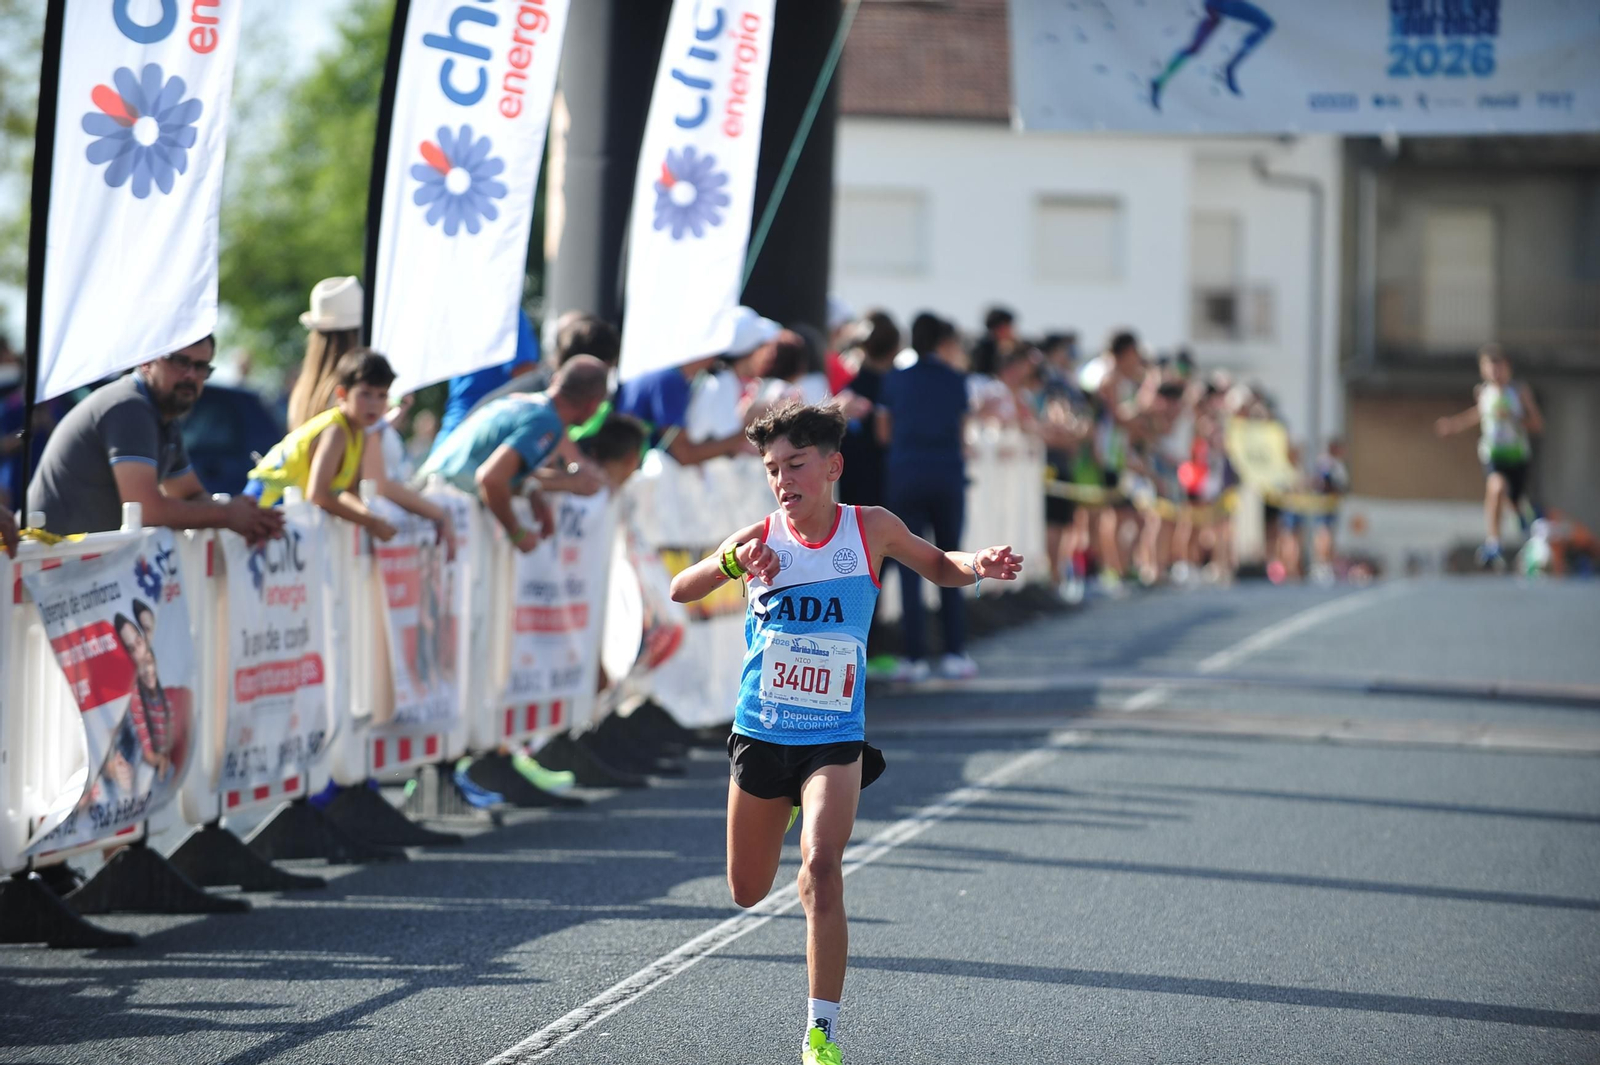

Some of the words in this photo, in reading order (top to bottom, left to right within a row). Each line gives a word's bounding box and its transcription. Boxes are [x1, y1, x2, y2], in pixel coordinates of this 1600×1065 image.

[1386, 41, 1496, 78] 2026
[754, 589, 845, 623] SADA
[772, 637, 790, 647] 2026
[794, 656, 812, 664] NICO
[773, 661, 831, 694] 3400
[783, 709, 840, 722] Deputación
[781, 720, 794, 730] DA
